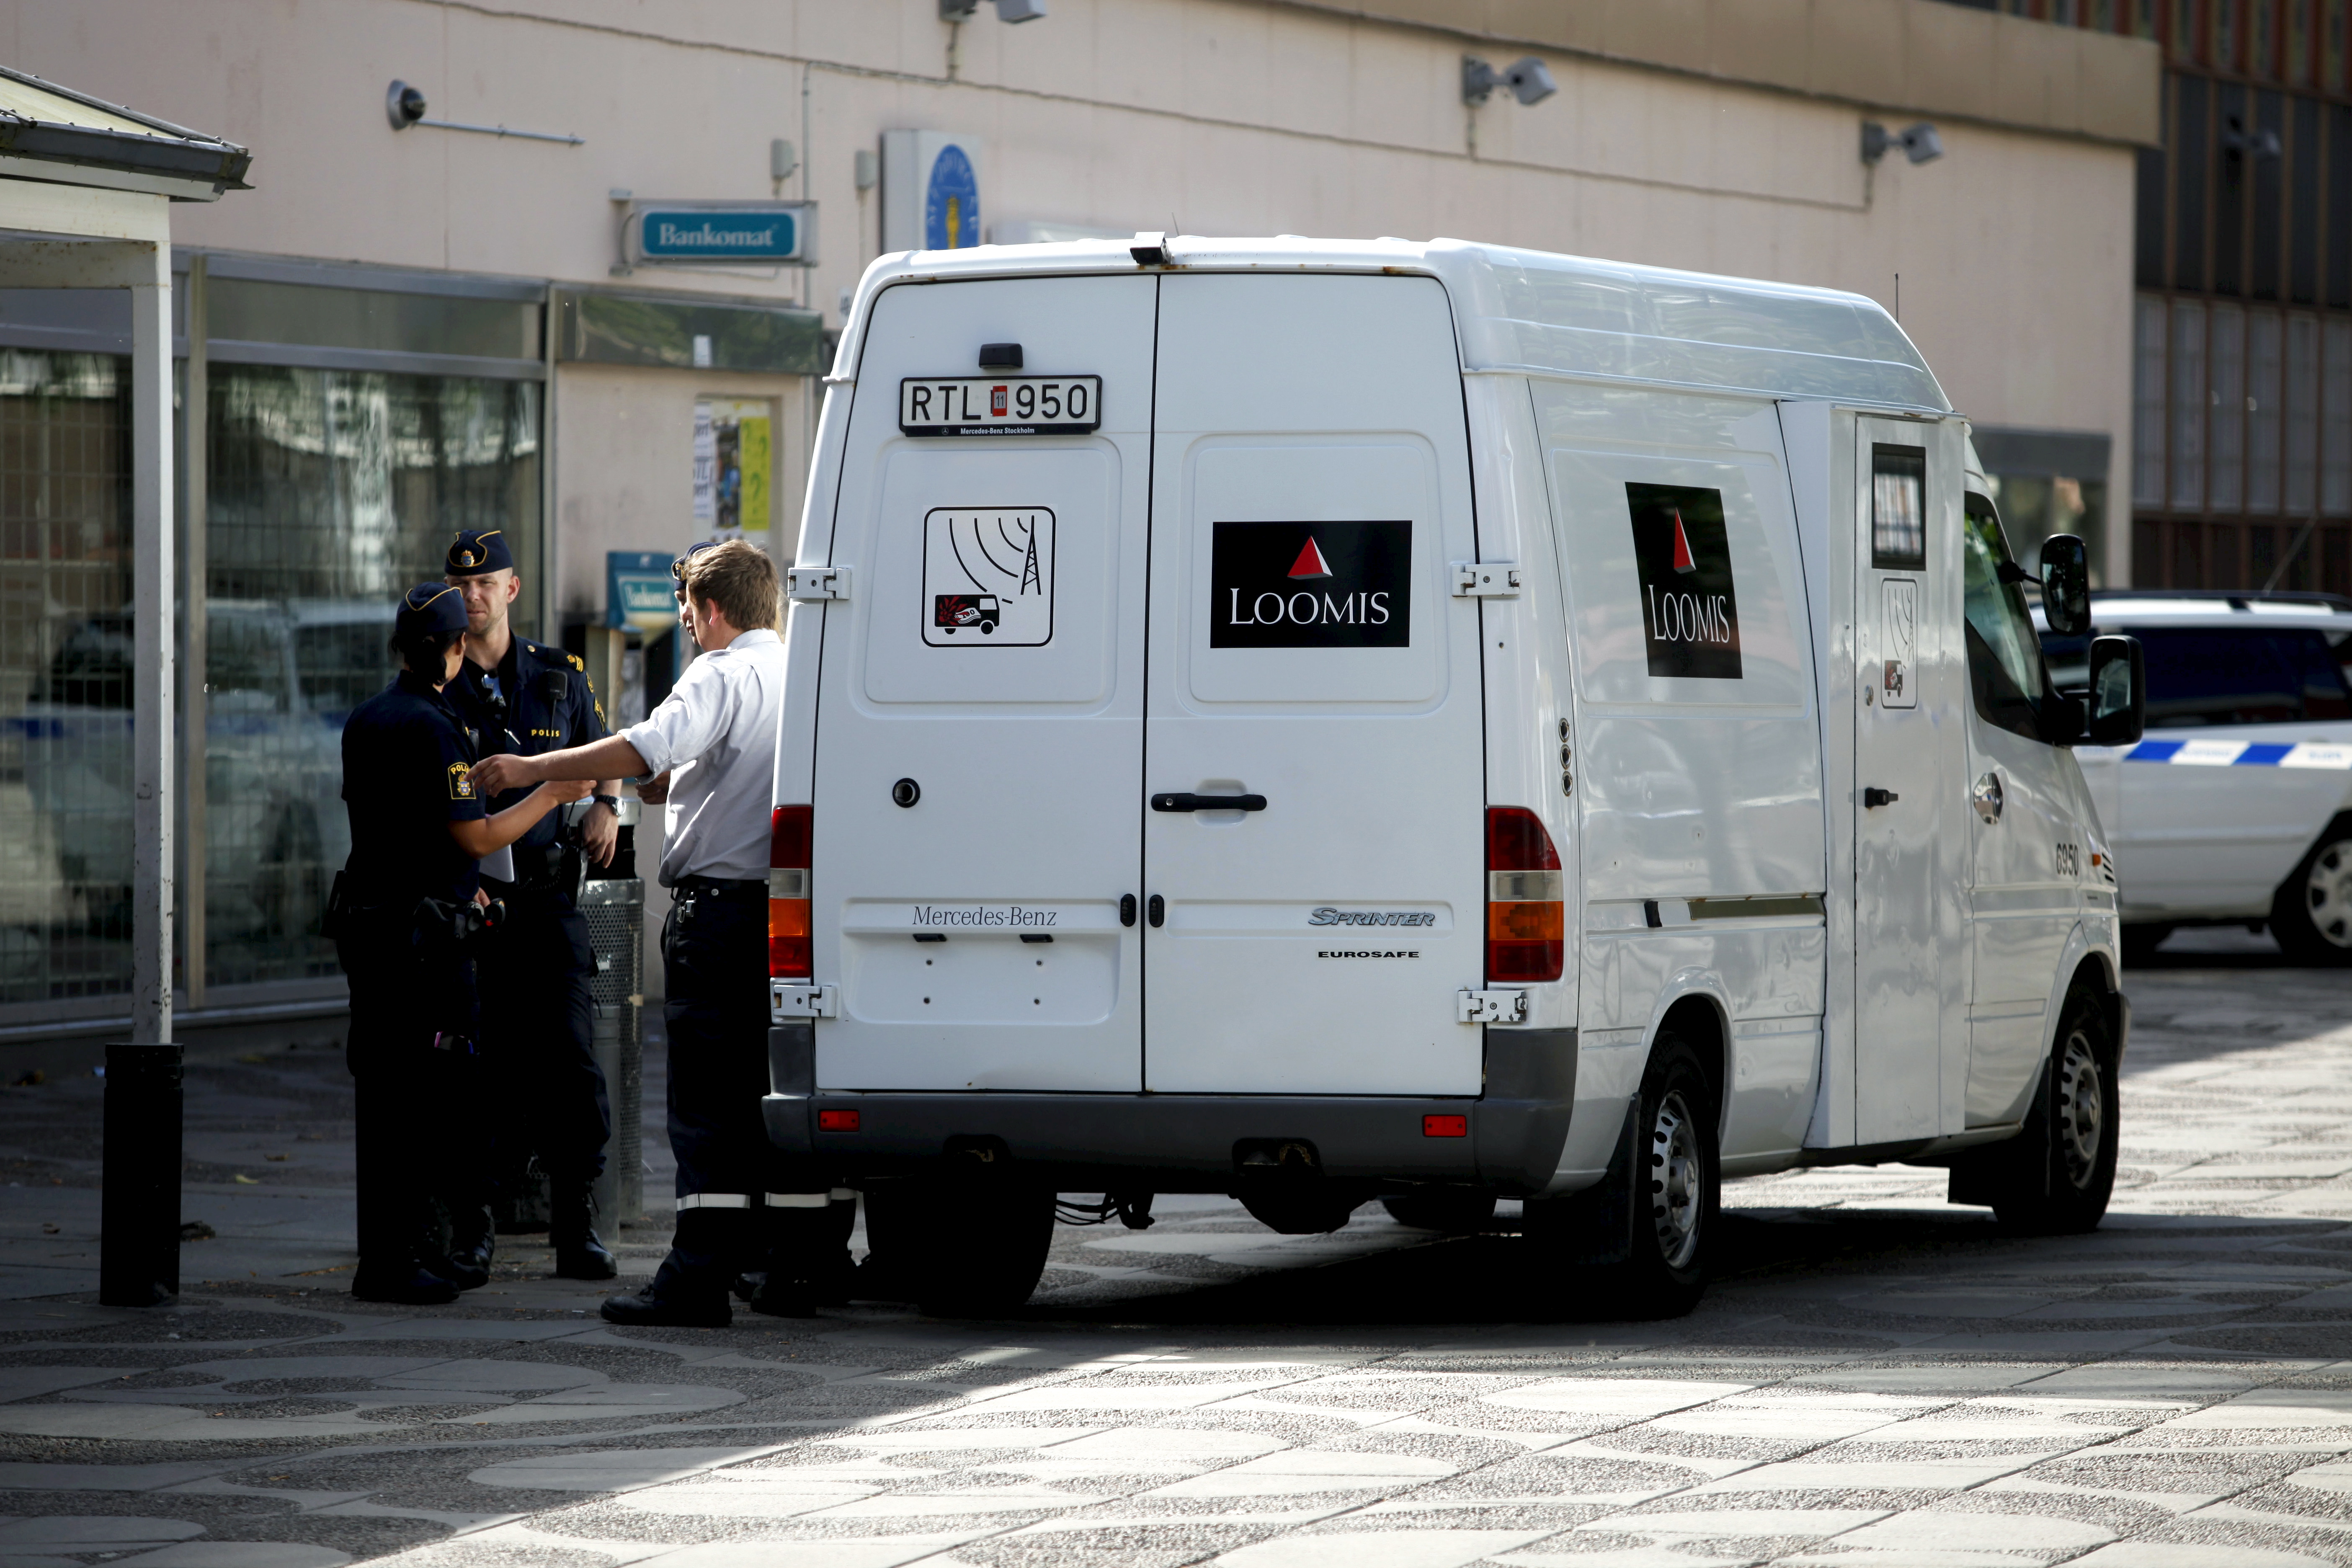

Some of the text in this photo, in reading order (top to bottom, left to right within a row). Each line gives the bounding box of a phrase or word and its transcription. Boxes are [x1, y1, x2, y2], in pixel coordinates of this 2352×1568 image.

[658, 222, 775, 247] Bankomat
[911, 384, 1087, 420] RTL 950
[996, 395, 1003, 407] 11
[1230, 588, 1389, 624] LOOMIS
[1648, 585, 1730, 643] LOOMIS
[2057, 843, 2079, 876] 6950
[912, 906, 1057, 926] Mercedes-Benz
[1308, 908, 1435, 926] SPRINTER
